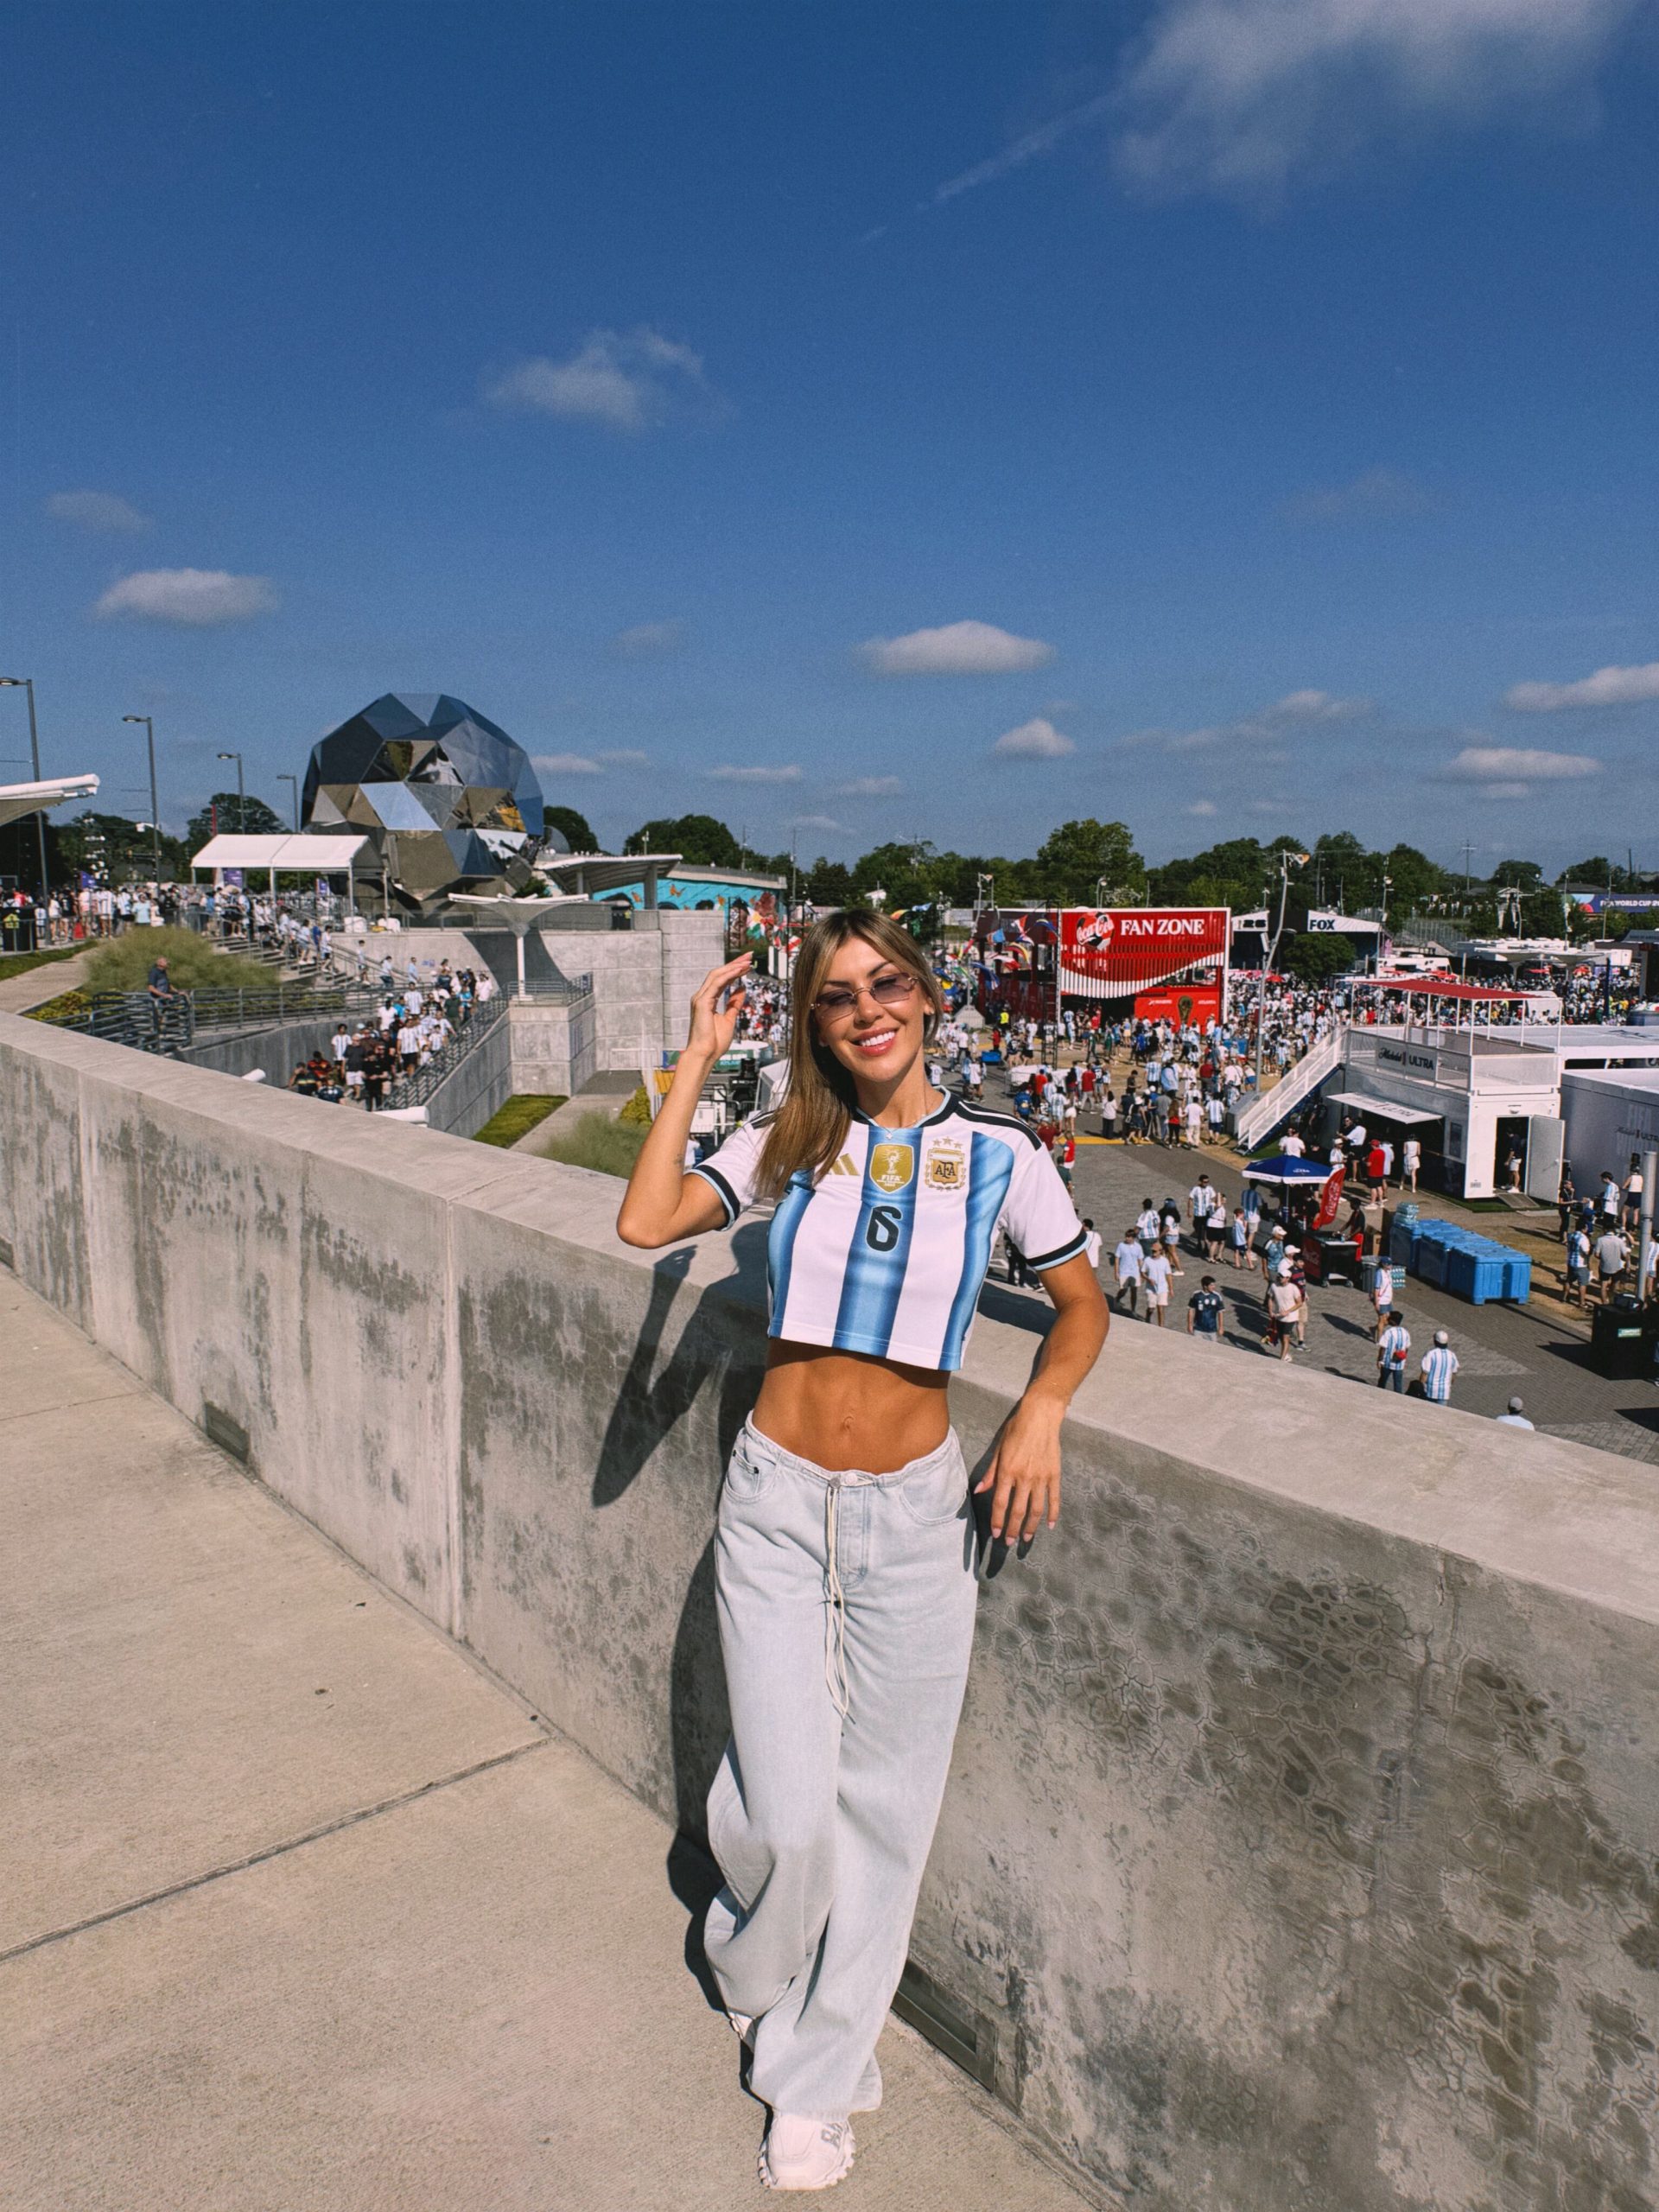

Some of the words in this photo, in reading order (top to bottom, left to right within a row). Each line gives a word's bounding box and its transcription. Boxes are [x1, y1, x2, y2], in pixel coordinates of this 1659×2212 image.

[1121, 919, 1154, 936] FAN
[1157, 918, 1205, 935] ZONE
[1310, 919, 1335, 930] FOX
[1409, 1055, 1433, 1070] ULTRA
[935, 1160, 956, 1179] AFA
[866, 1205, 902, 1252] 6
